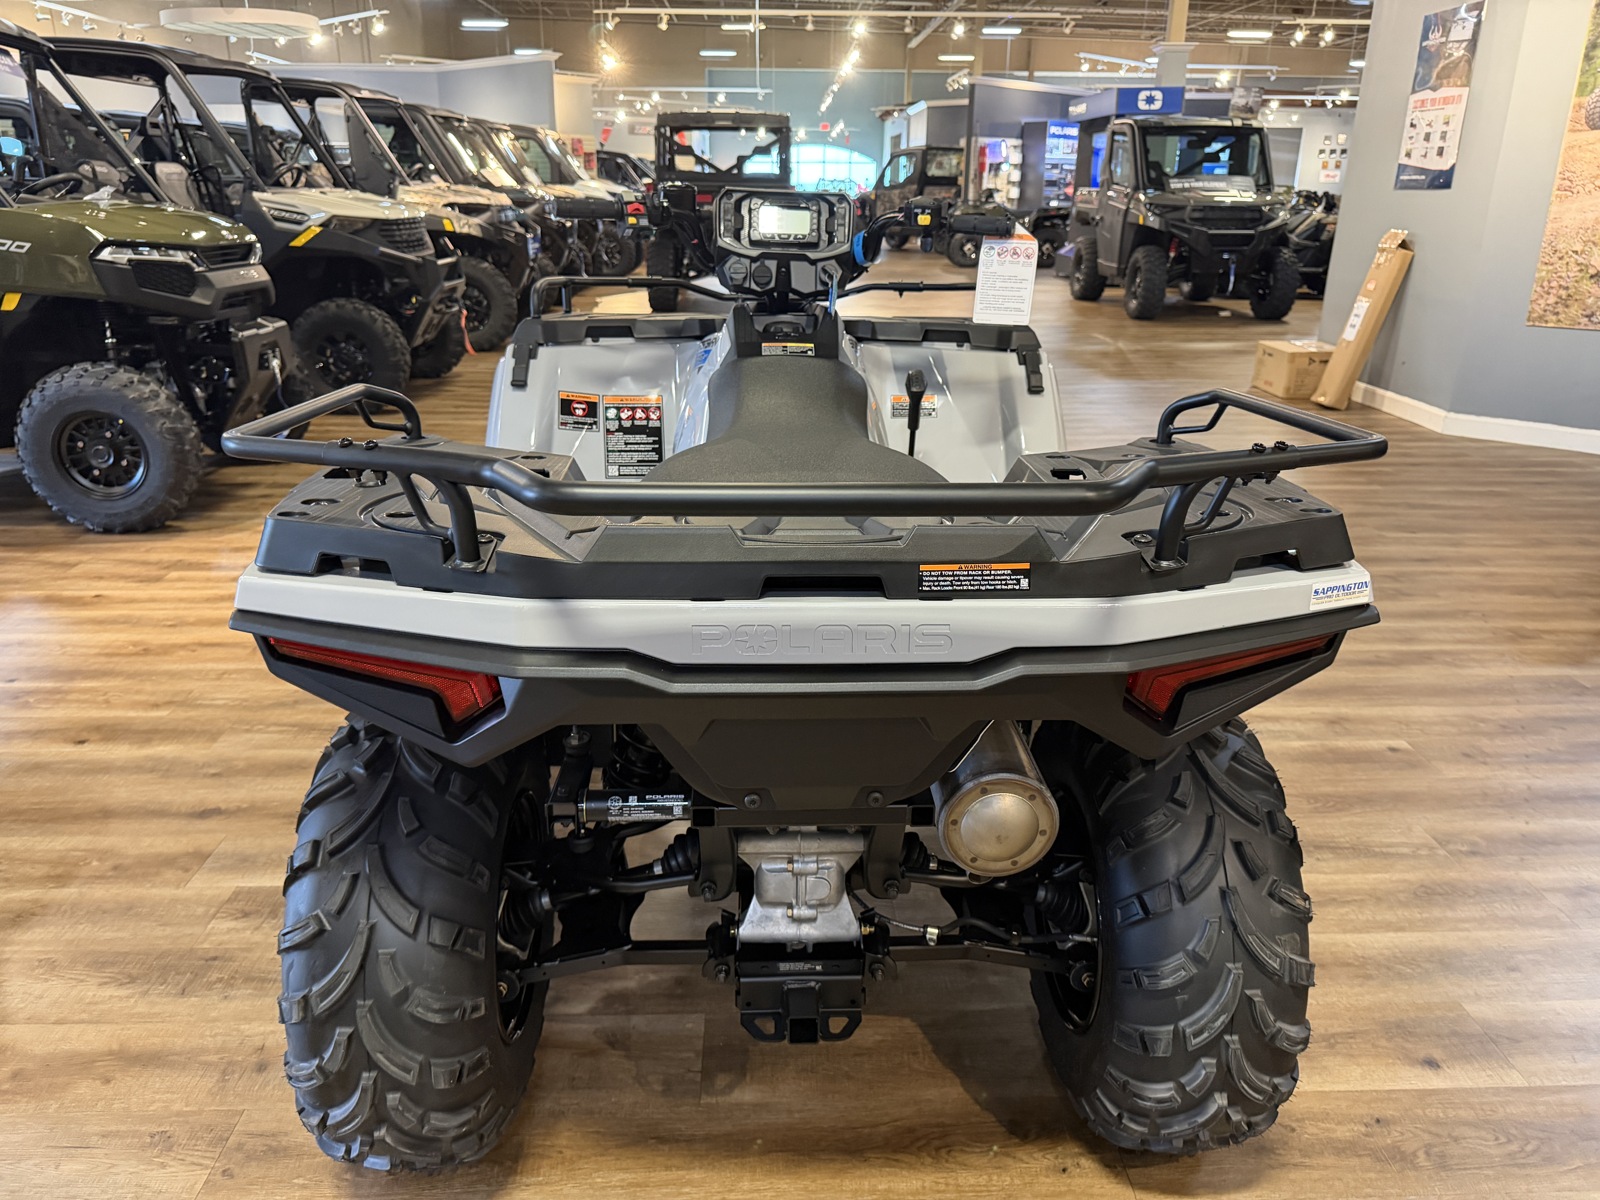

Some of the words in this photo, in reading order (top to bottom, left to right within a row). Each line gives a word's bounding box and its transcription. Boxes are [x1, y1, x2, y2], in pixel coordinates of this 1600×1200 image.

[1049, 125, 1079, 136] POLARIS
[575, 408, 584, 416] 10
[1313, 581, 1370, 597] SAPPINGTON
[690, 623, 954, 656] POLARIS
